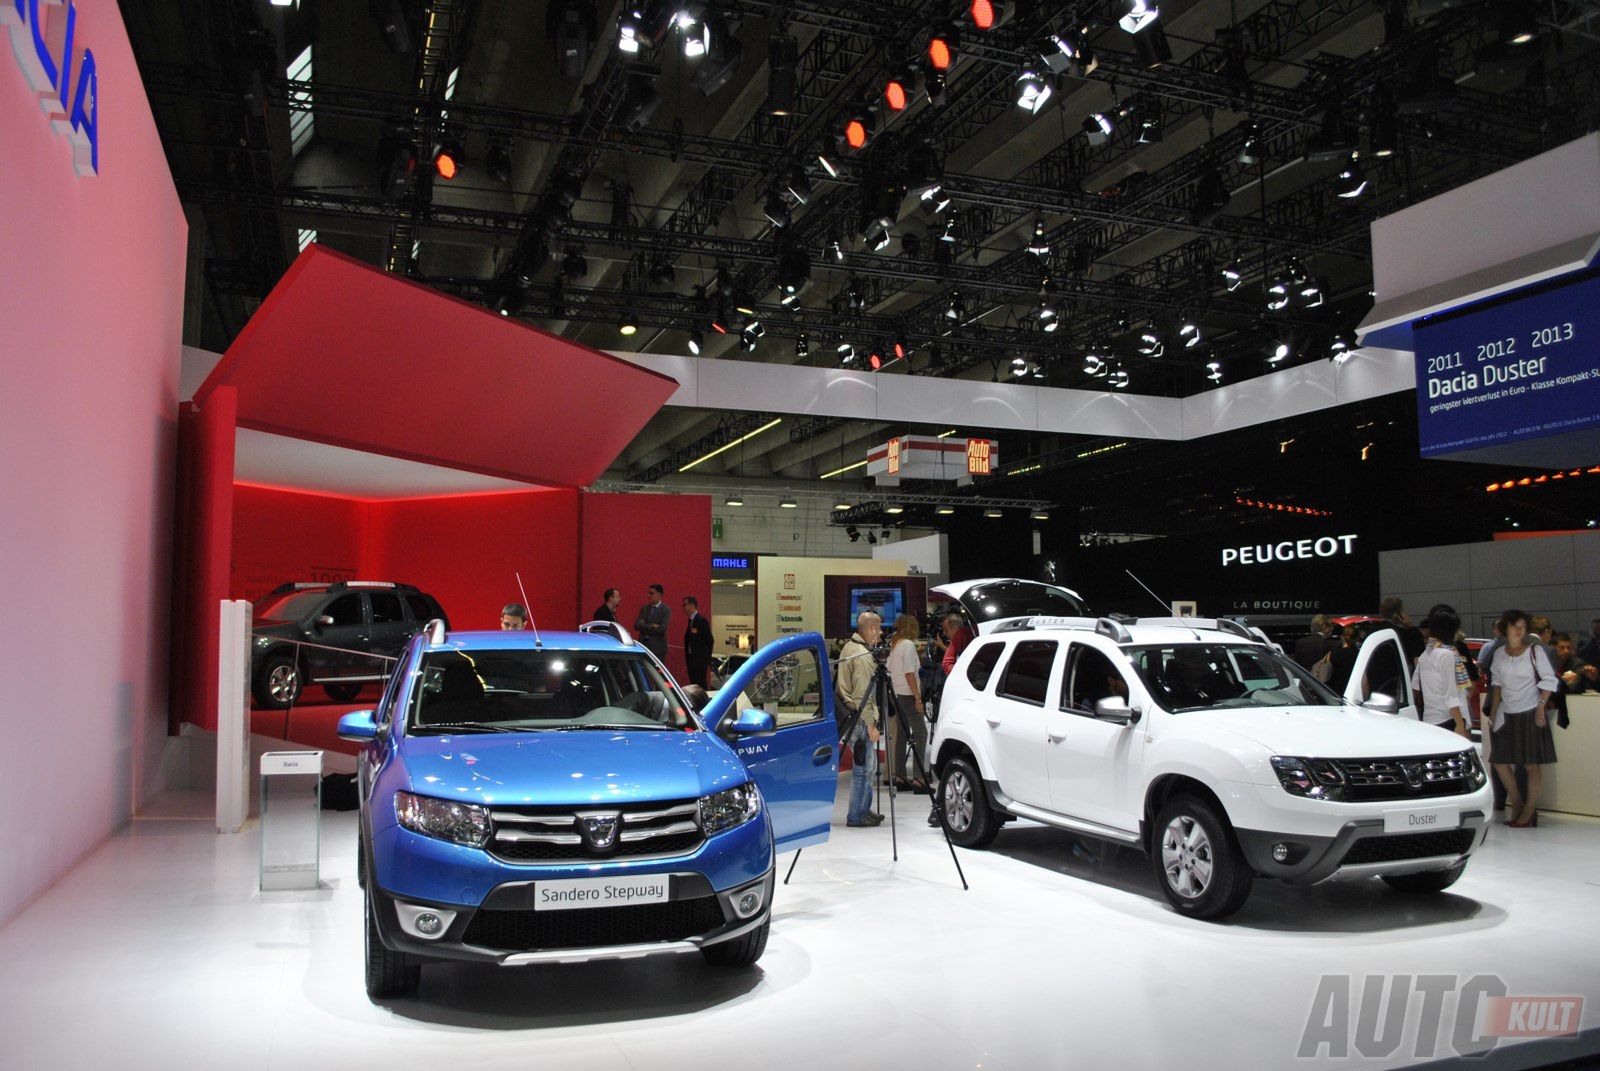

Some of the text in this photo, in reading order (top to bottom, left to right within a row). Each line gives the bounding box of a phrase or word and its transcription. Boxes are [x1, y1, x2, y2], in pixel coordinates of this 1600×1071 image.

[1428, 323, 1574, 373] 2011 2012 2013
[1428, 356, 1547, 399] Dacia Duster
[1429, 400, 1461, 414] geringster
[1462, 390, 1501, 405] Wertverlust
[1501, 388, 1509, 398] in
[1509, 386, 1526, 396] Euro
[1531, 379, 1555, 391] Klasse
[968, 440, 990, 457] Auto
[969, 457, 989, 473] Bild
[1222, 534, 1357, 566] PEUGEOT
[712, 558, 747, 568] MAHLE
[1233, 600, 1321, 610] LA BOUTIQUE
[1408, 814, 1438, 826] Duster
[541, 885, 664, 902] Sandero Stepway
